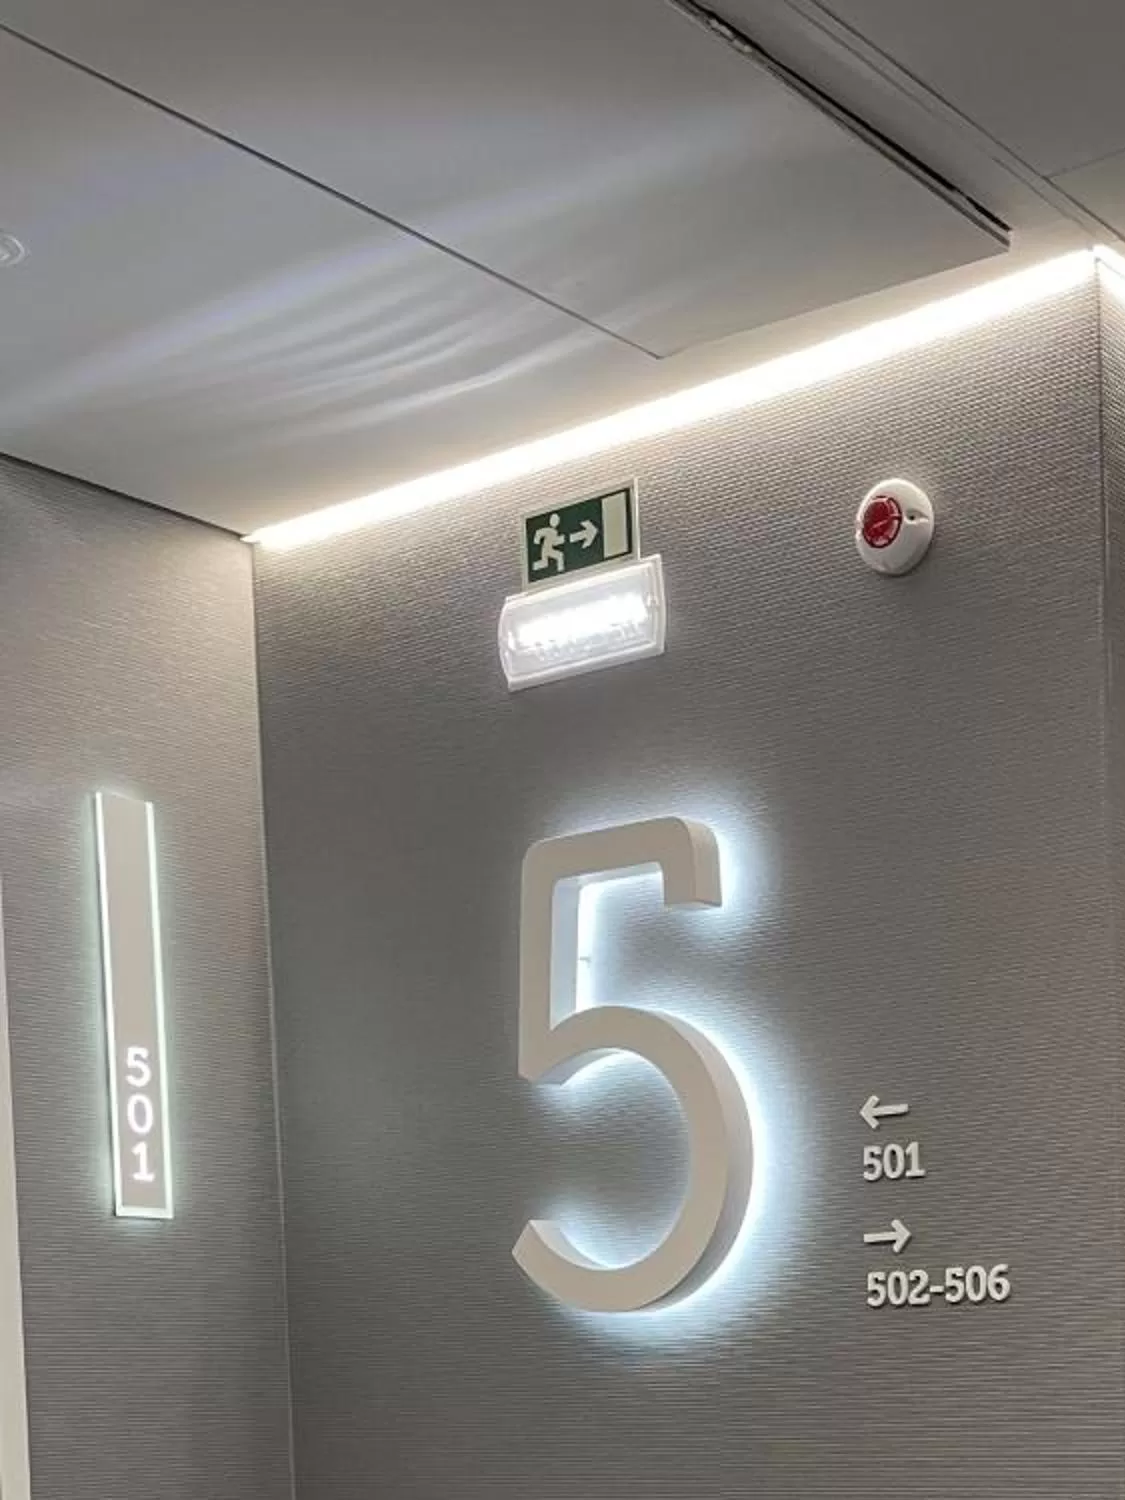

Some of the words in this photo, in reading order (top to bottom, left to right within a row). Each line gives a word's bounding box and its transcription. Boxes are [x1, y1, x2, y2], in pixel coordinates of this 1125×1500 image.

[511, 816, 754, 1314] 5
[125, 1046, 156, 1183] 501
[863, 1141, 926, 1181] 501
[866, 1263, 1011, 1307] 502-506
